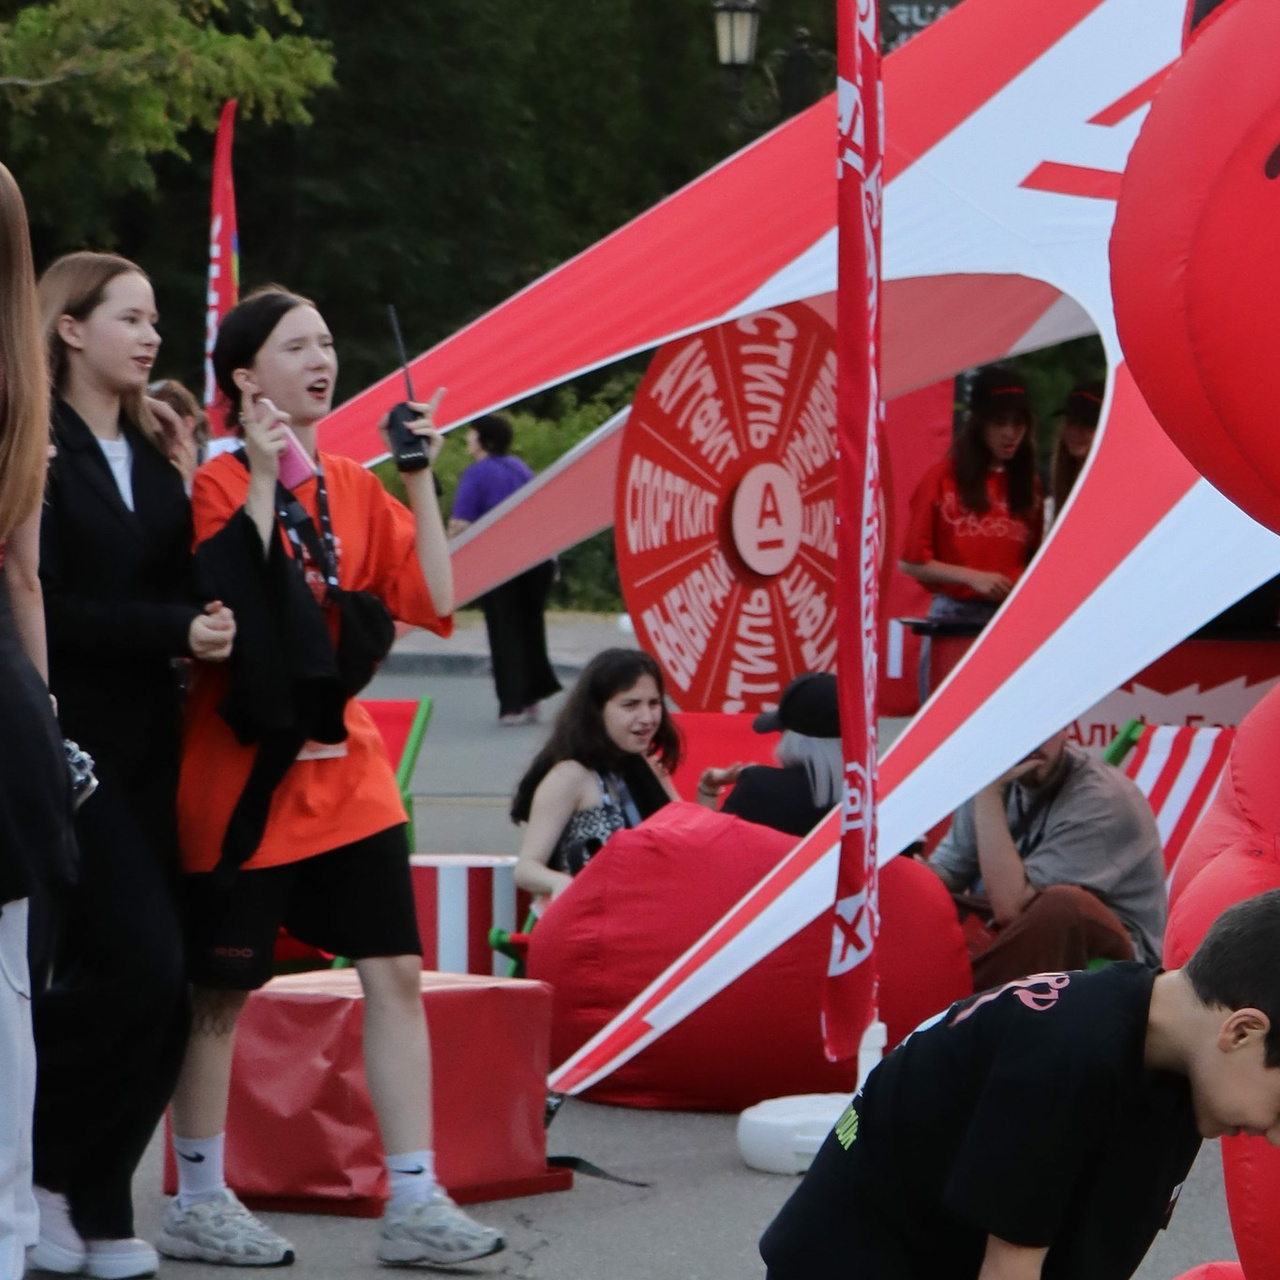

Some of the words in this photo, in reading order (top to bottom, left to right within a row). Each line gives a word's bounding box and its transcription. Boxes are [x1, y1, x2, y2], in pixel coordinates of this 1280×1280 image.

[649, 337, 740, 474] АУТФИТ
[736, 309, 799, 450] СТИЛЬ
[626, 453, 719, 555] СПОРТКИТ
[641, 546, 736, 693] ВЫБИРАЙ
[778, 563, 838, 675] УТФИТ
